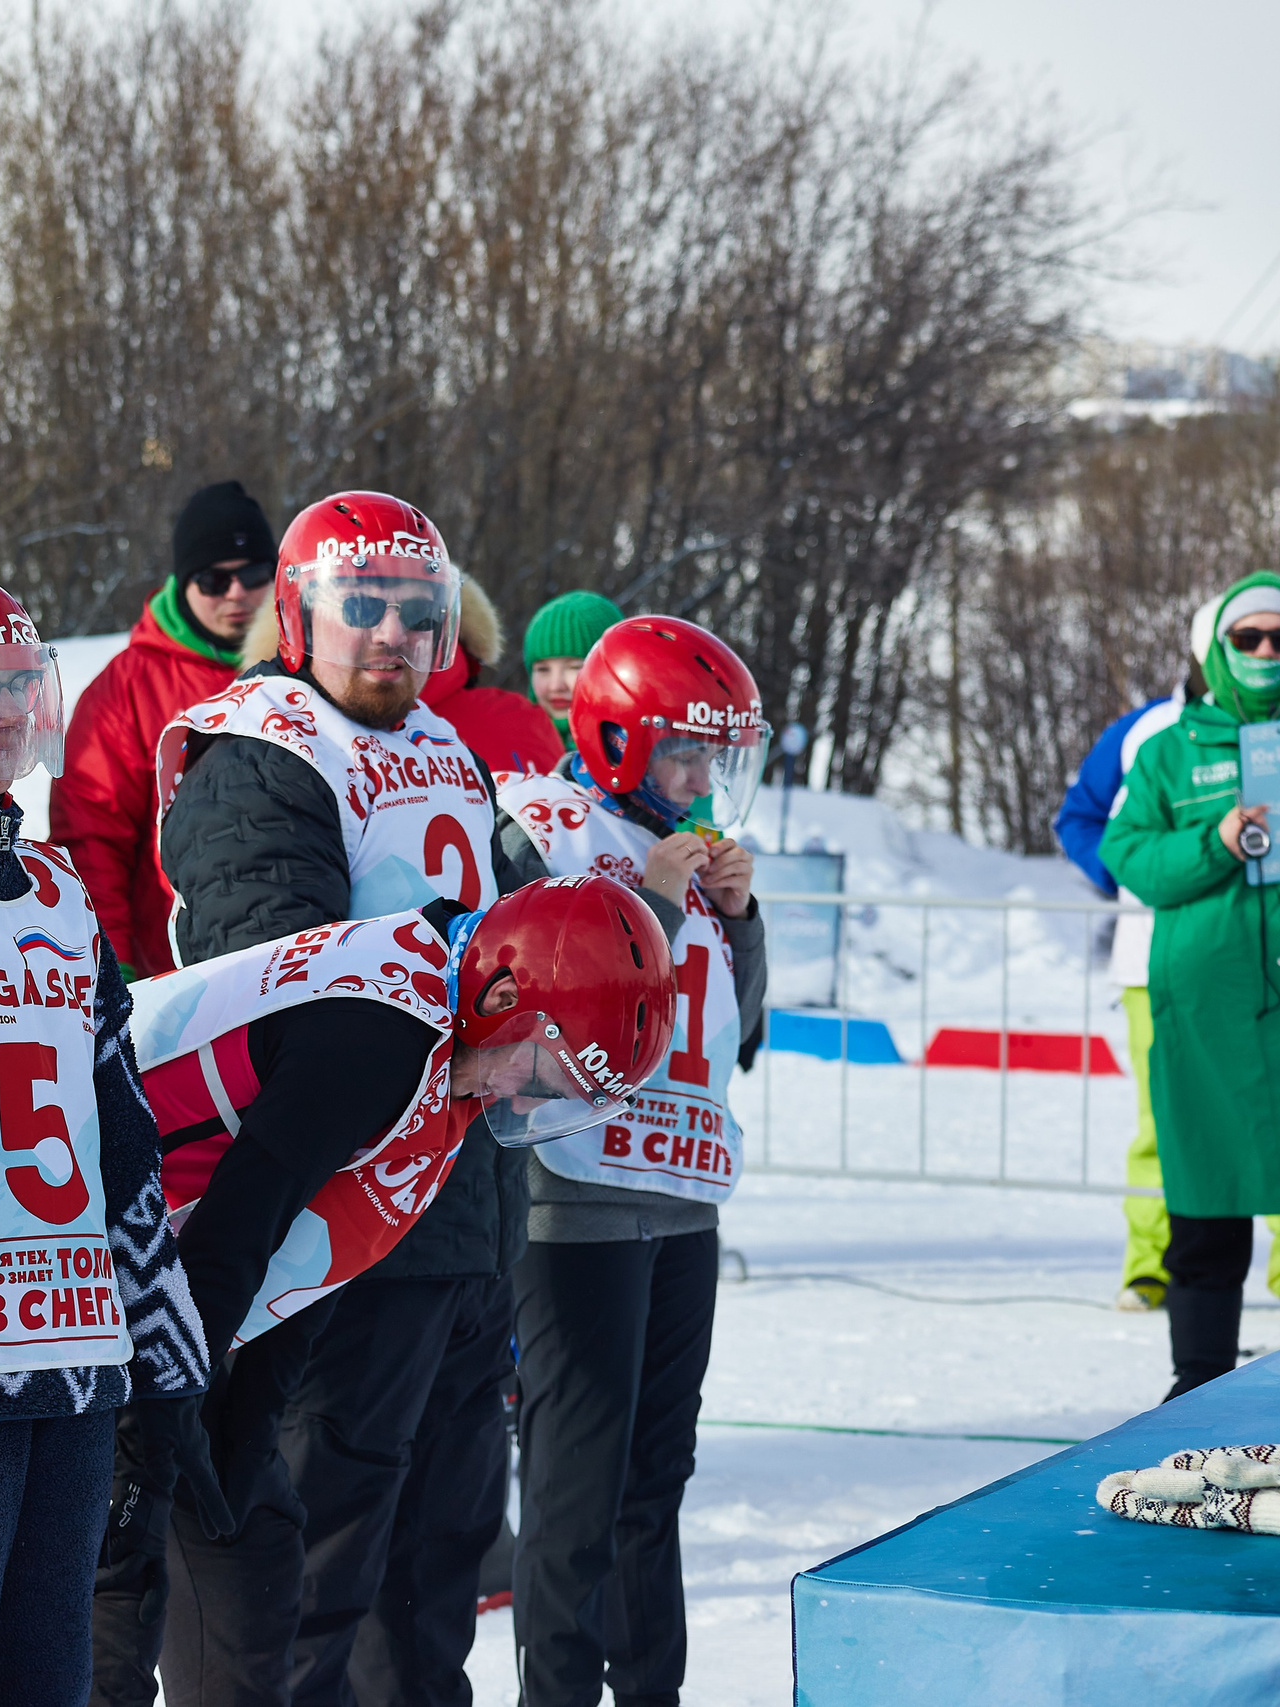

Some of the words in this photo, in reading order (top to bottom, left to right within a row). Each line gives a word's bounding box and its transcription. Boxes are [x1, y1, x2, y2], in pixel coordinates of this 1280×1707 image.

[668, 943, 709, 1088] 1
[558, 1049, 594, 1093] МУРМАНСК
[602, 1124, 632, 1158] В
[16, 1250, 52, 1266] ТЕХ,
[8, 1269, 53, 1285] ЗНАЕТ
